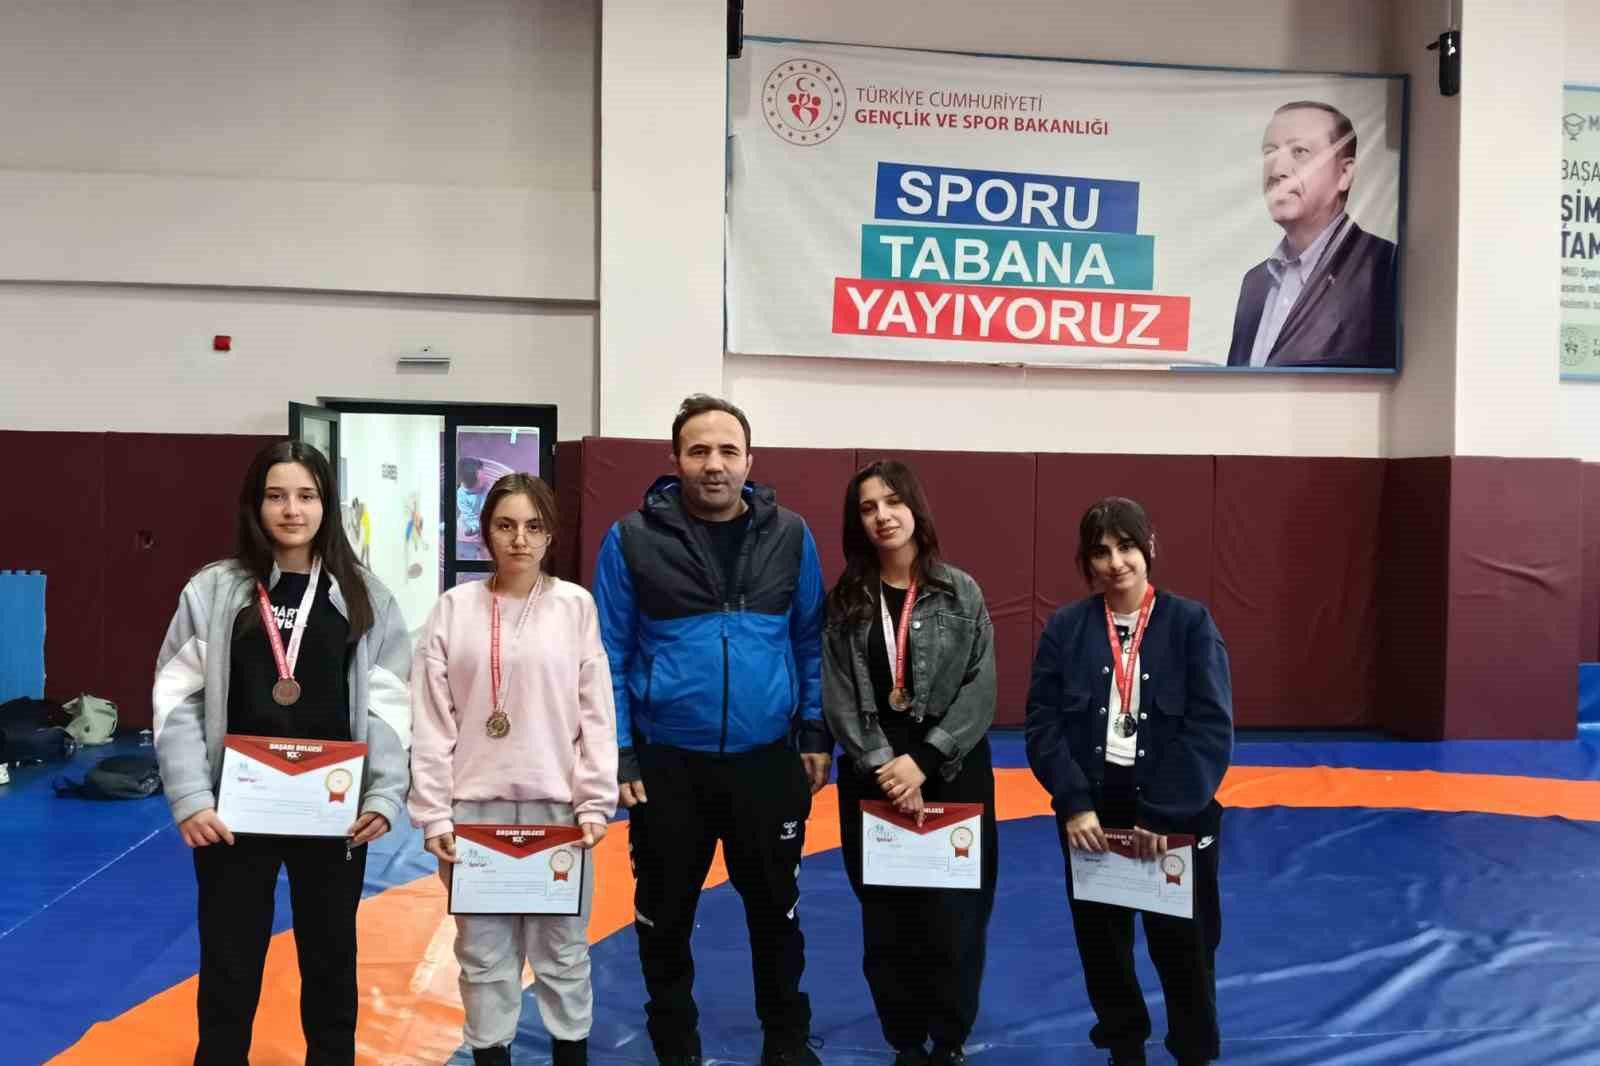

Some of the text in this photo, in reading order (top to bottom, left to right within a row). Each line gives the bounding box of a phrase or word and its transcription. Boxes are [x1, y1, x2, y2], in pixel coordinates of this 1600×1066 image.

[854, 108, 1109, 136] GENÇLİK VE SPOR BAKANLIĞI
[856, 86, 1043, 113] TÜRKİYE CUMHURİYETİ
[896, 170, 1101, 230] SPORU
[879, 234, 1116, 286] TABANA
[846, 286, 1161, 346] YAYIYORUZ
